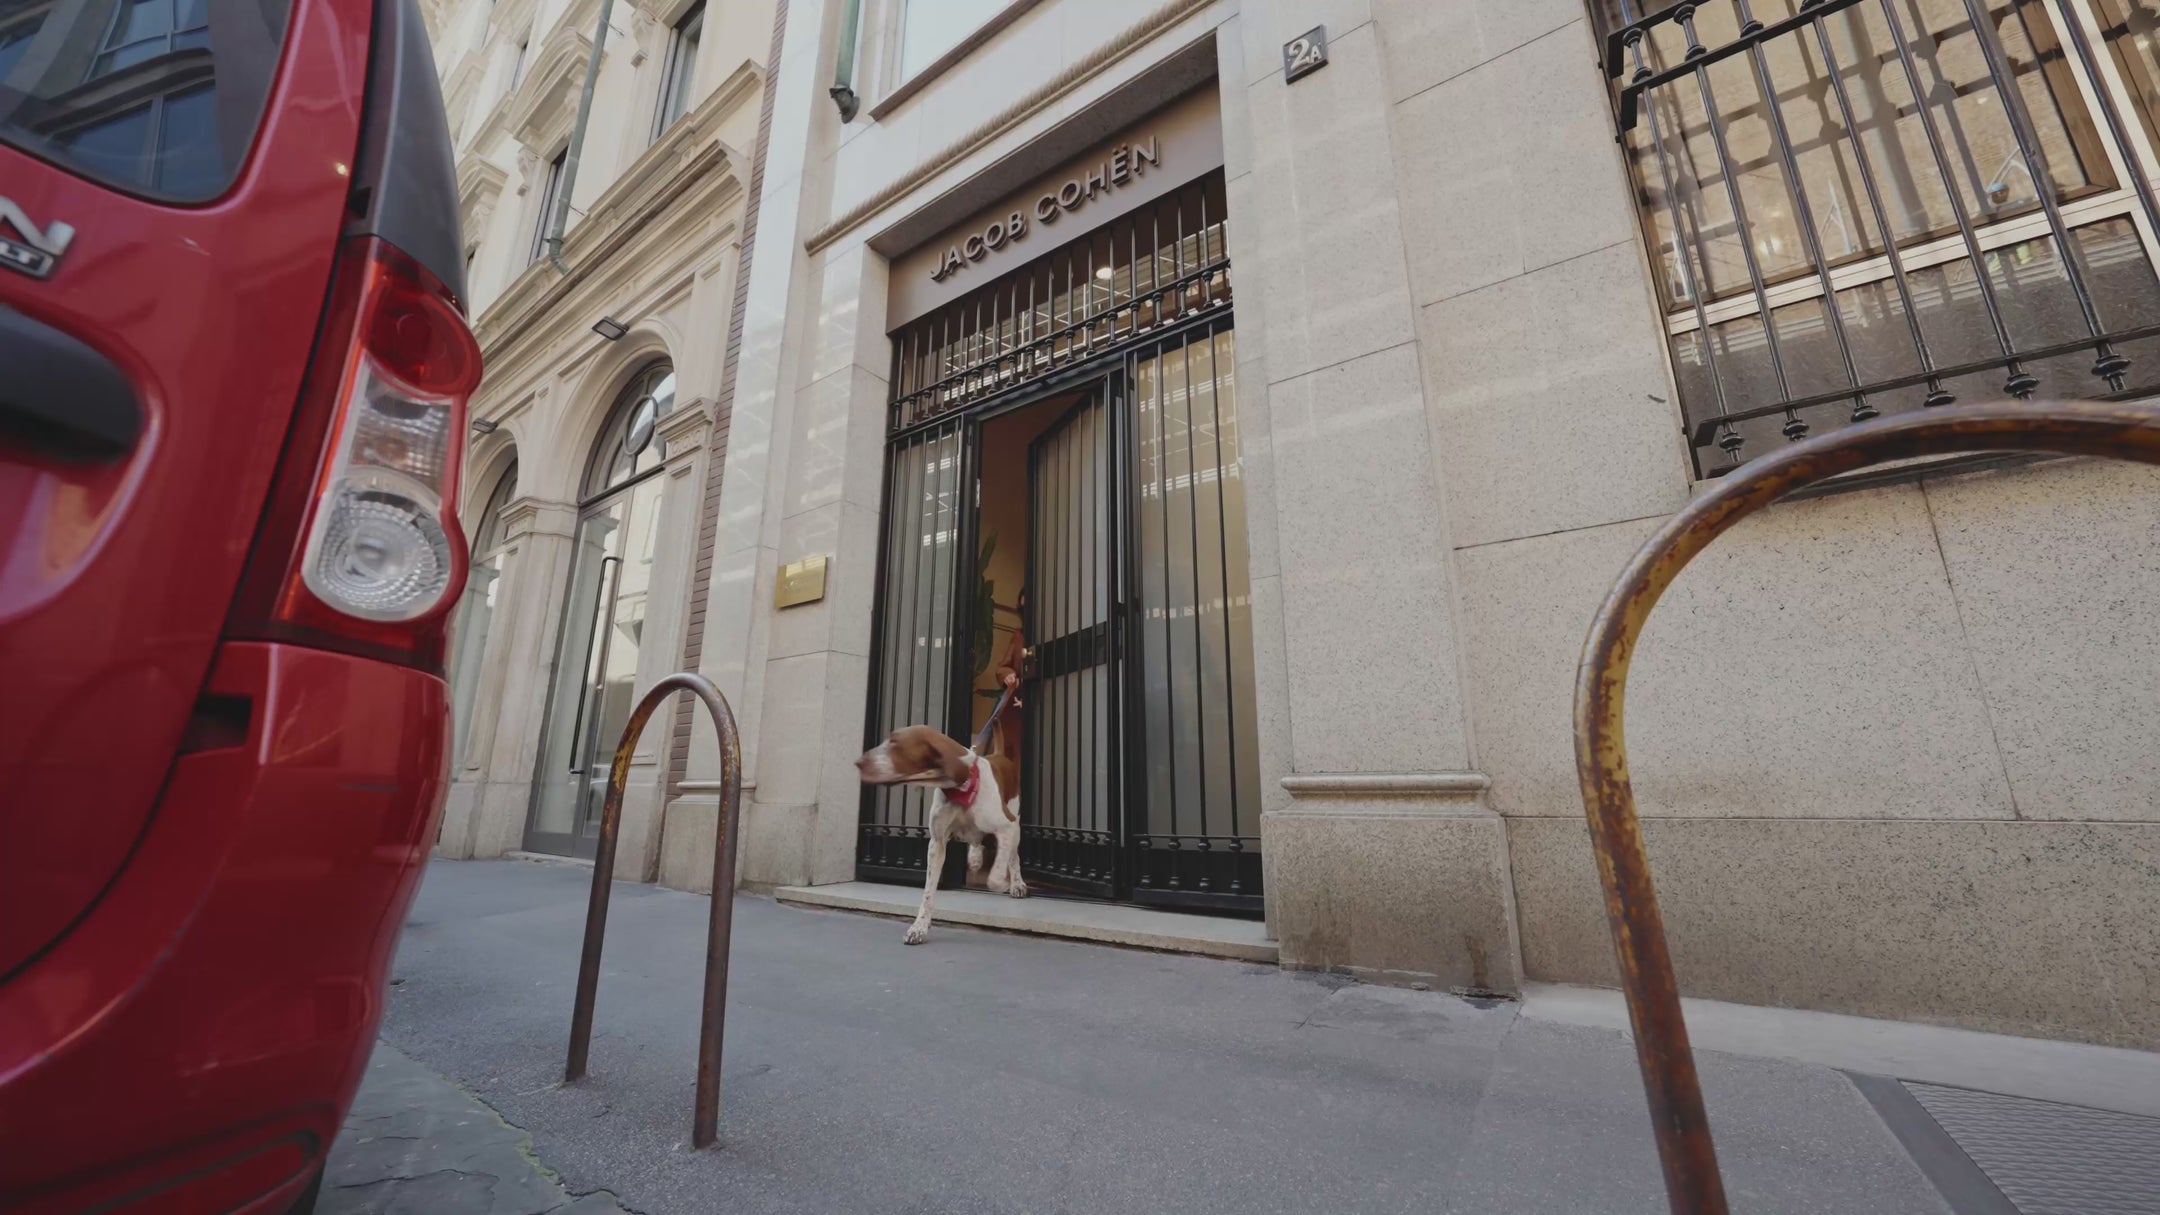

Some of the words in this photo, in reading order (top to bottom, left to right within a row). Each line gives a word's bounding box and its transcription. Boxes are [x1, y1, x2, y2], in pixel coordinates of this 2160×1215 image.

[1289, 39, 1322, 72] 2A
[930, 209, 1027, 281] JACOB
[1035, 135, 1160, 224] COHËN
